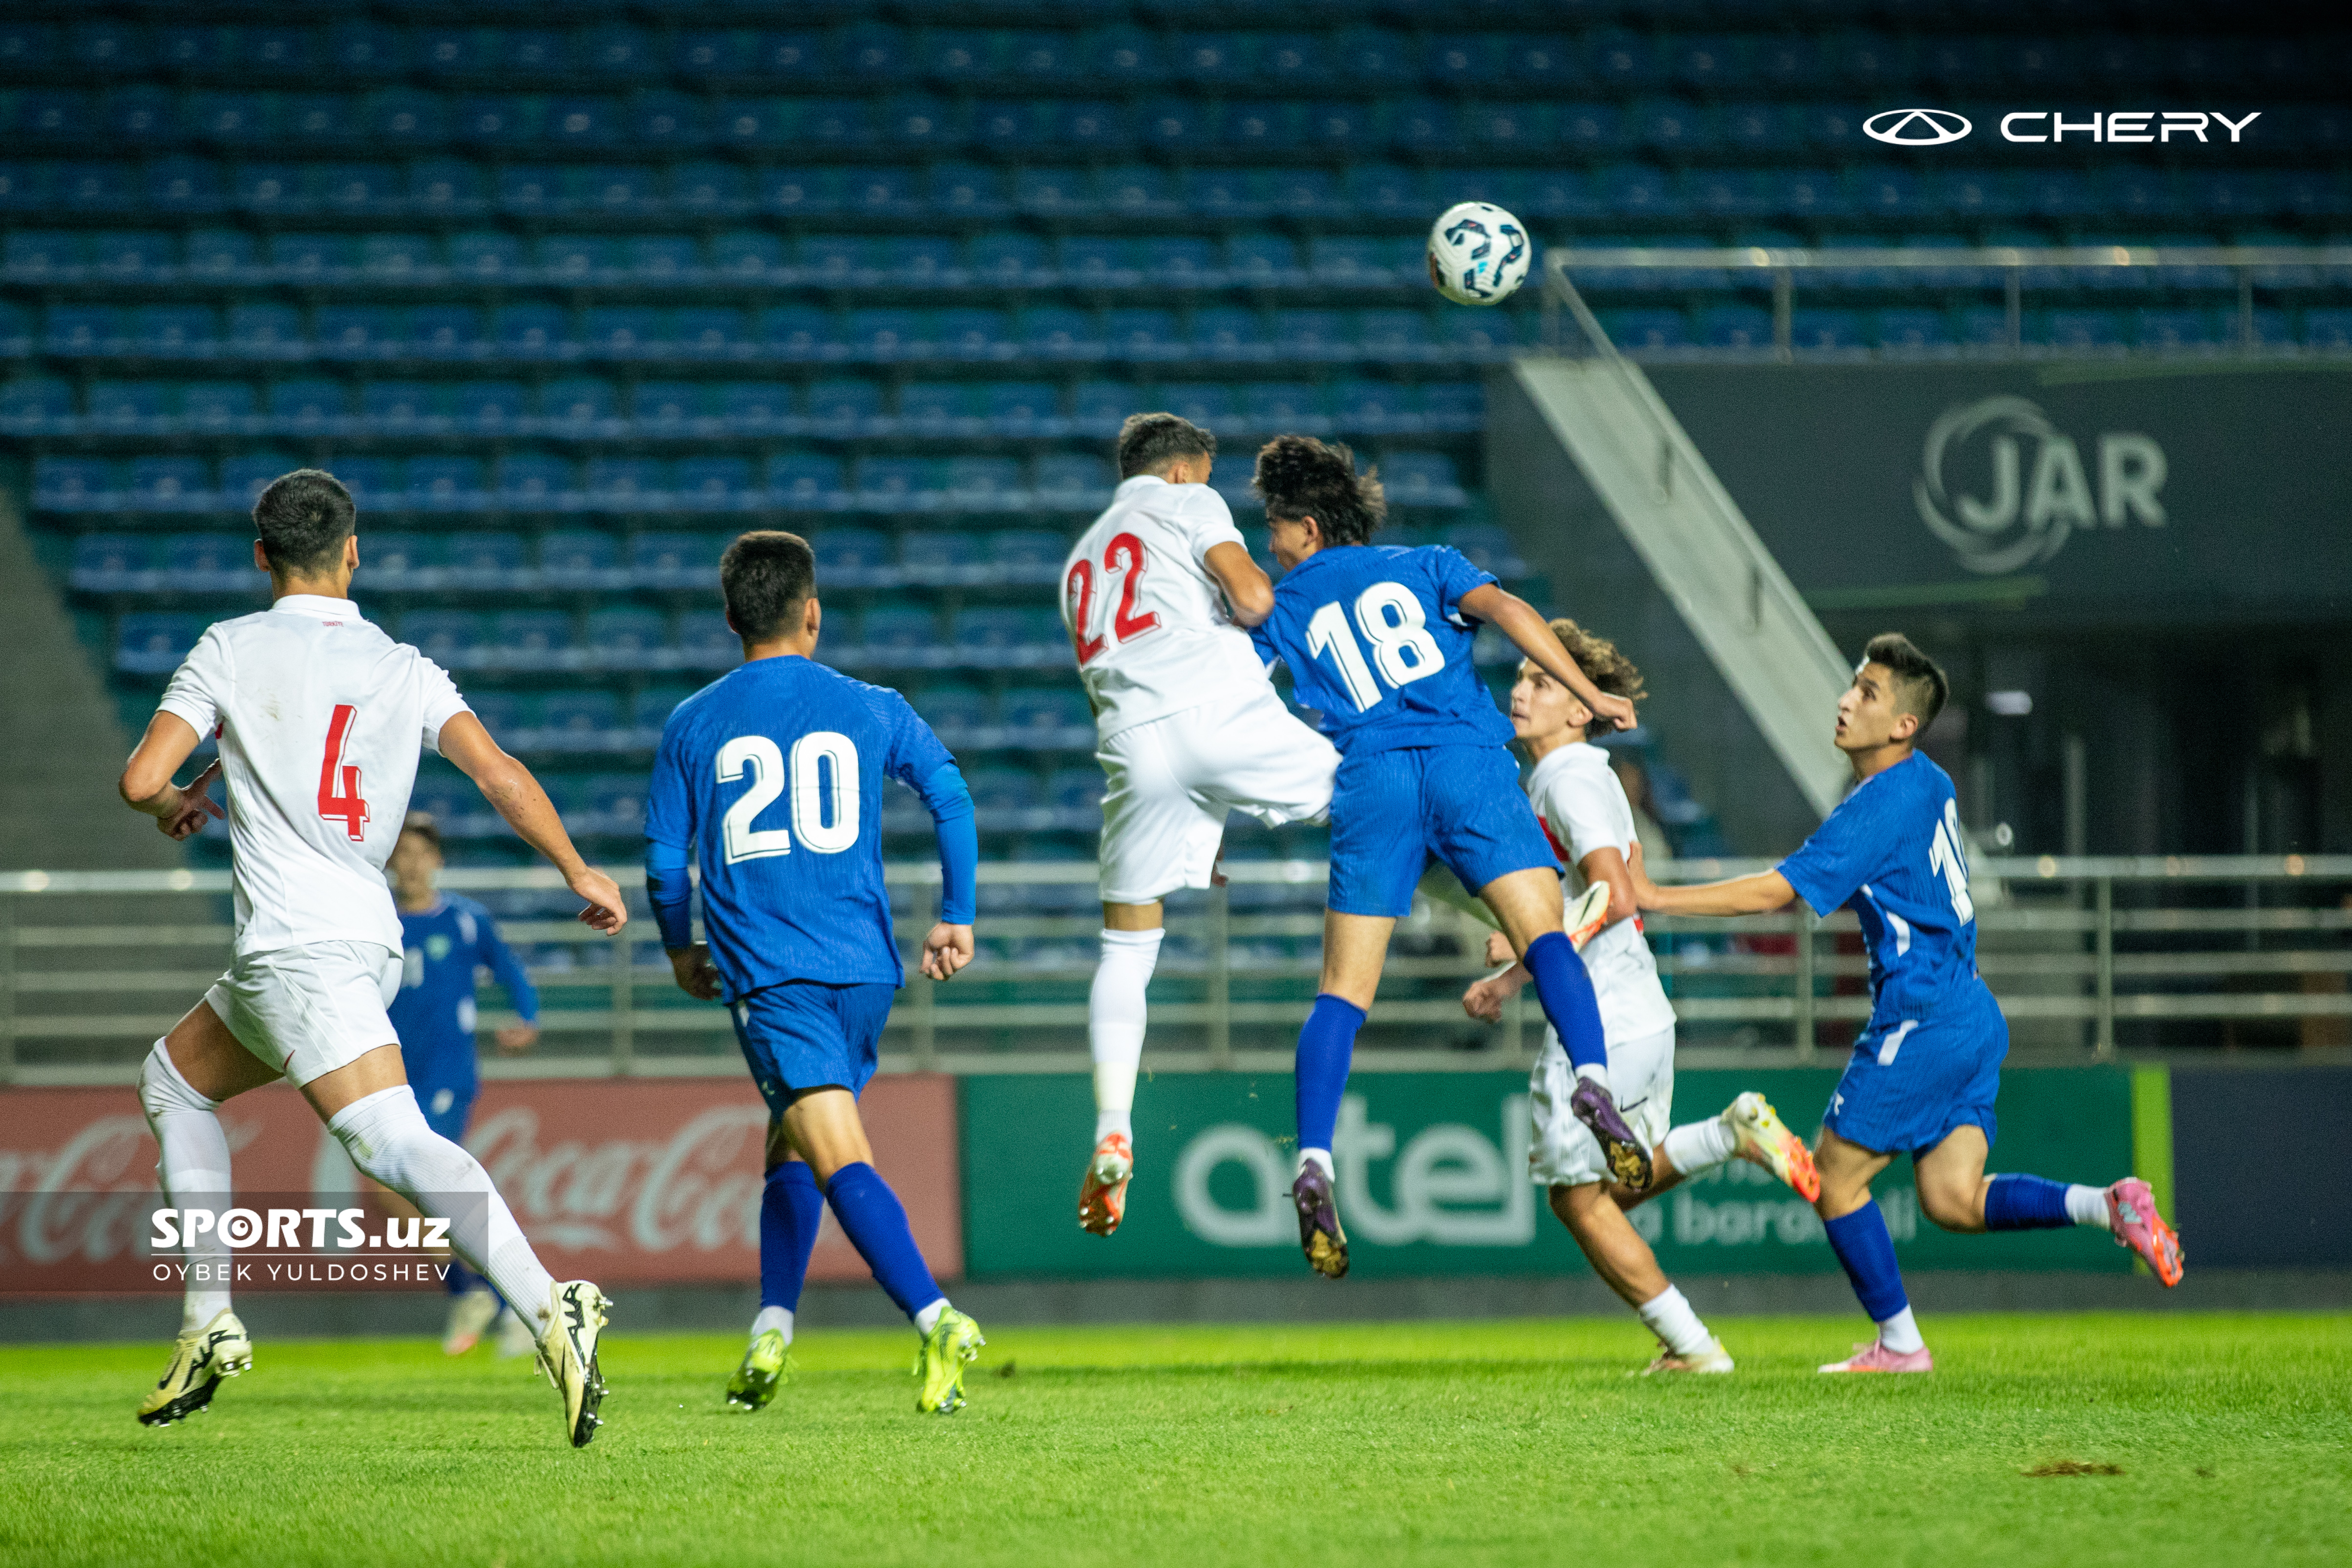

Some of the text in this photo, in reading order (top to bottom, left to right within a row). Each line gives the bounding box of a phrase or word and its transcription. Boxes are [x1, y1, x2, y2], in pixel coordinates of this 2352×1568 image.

[1957, 432, 2169, 532] JAR
[1067, 532, 1162, 672] 22
[1306, 581, 1445, 713] 18
[318, 704, 370, 842] 4
[715, 731, 860, 866] 20
[1177, 1093, 1536, 1247] atel
